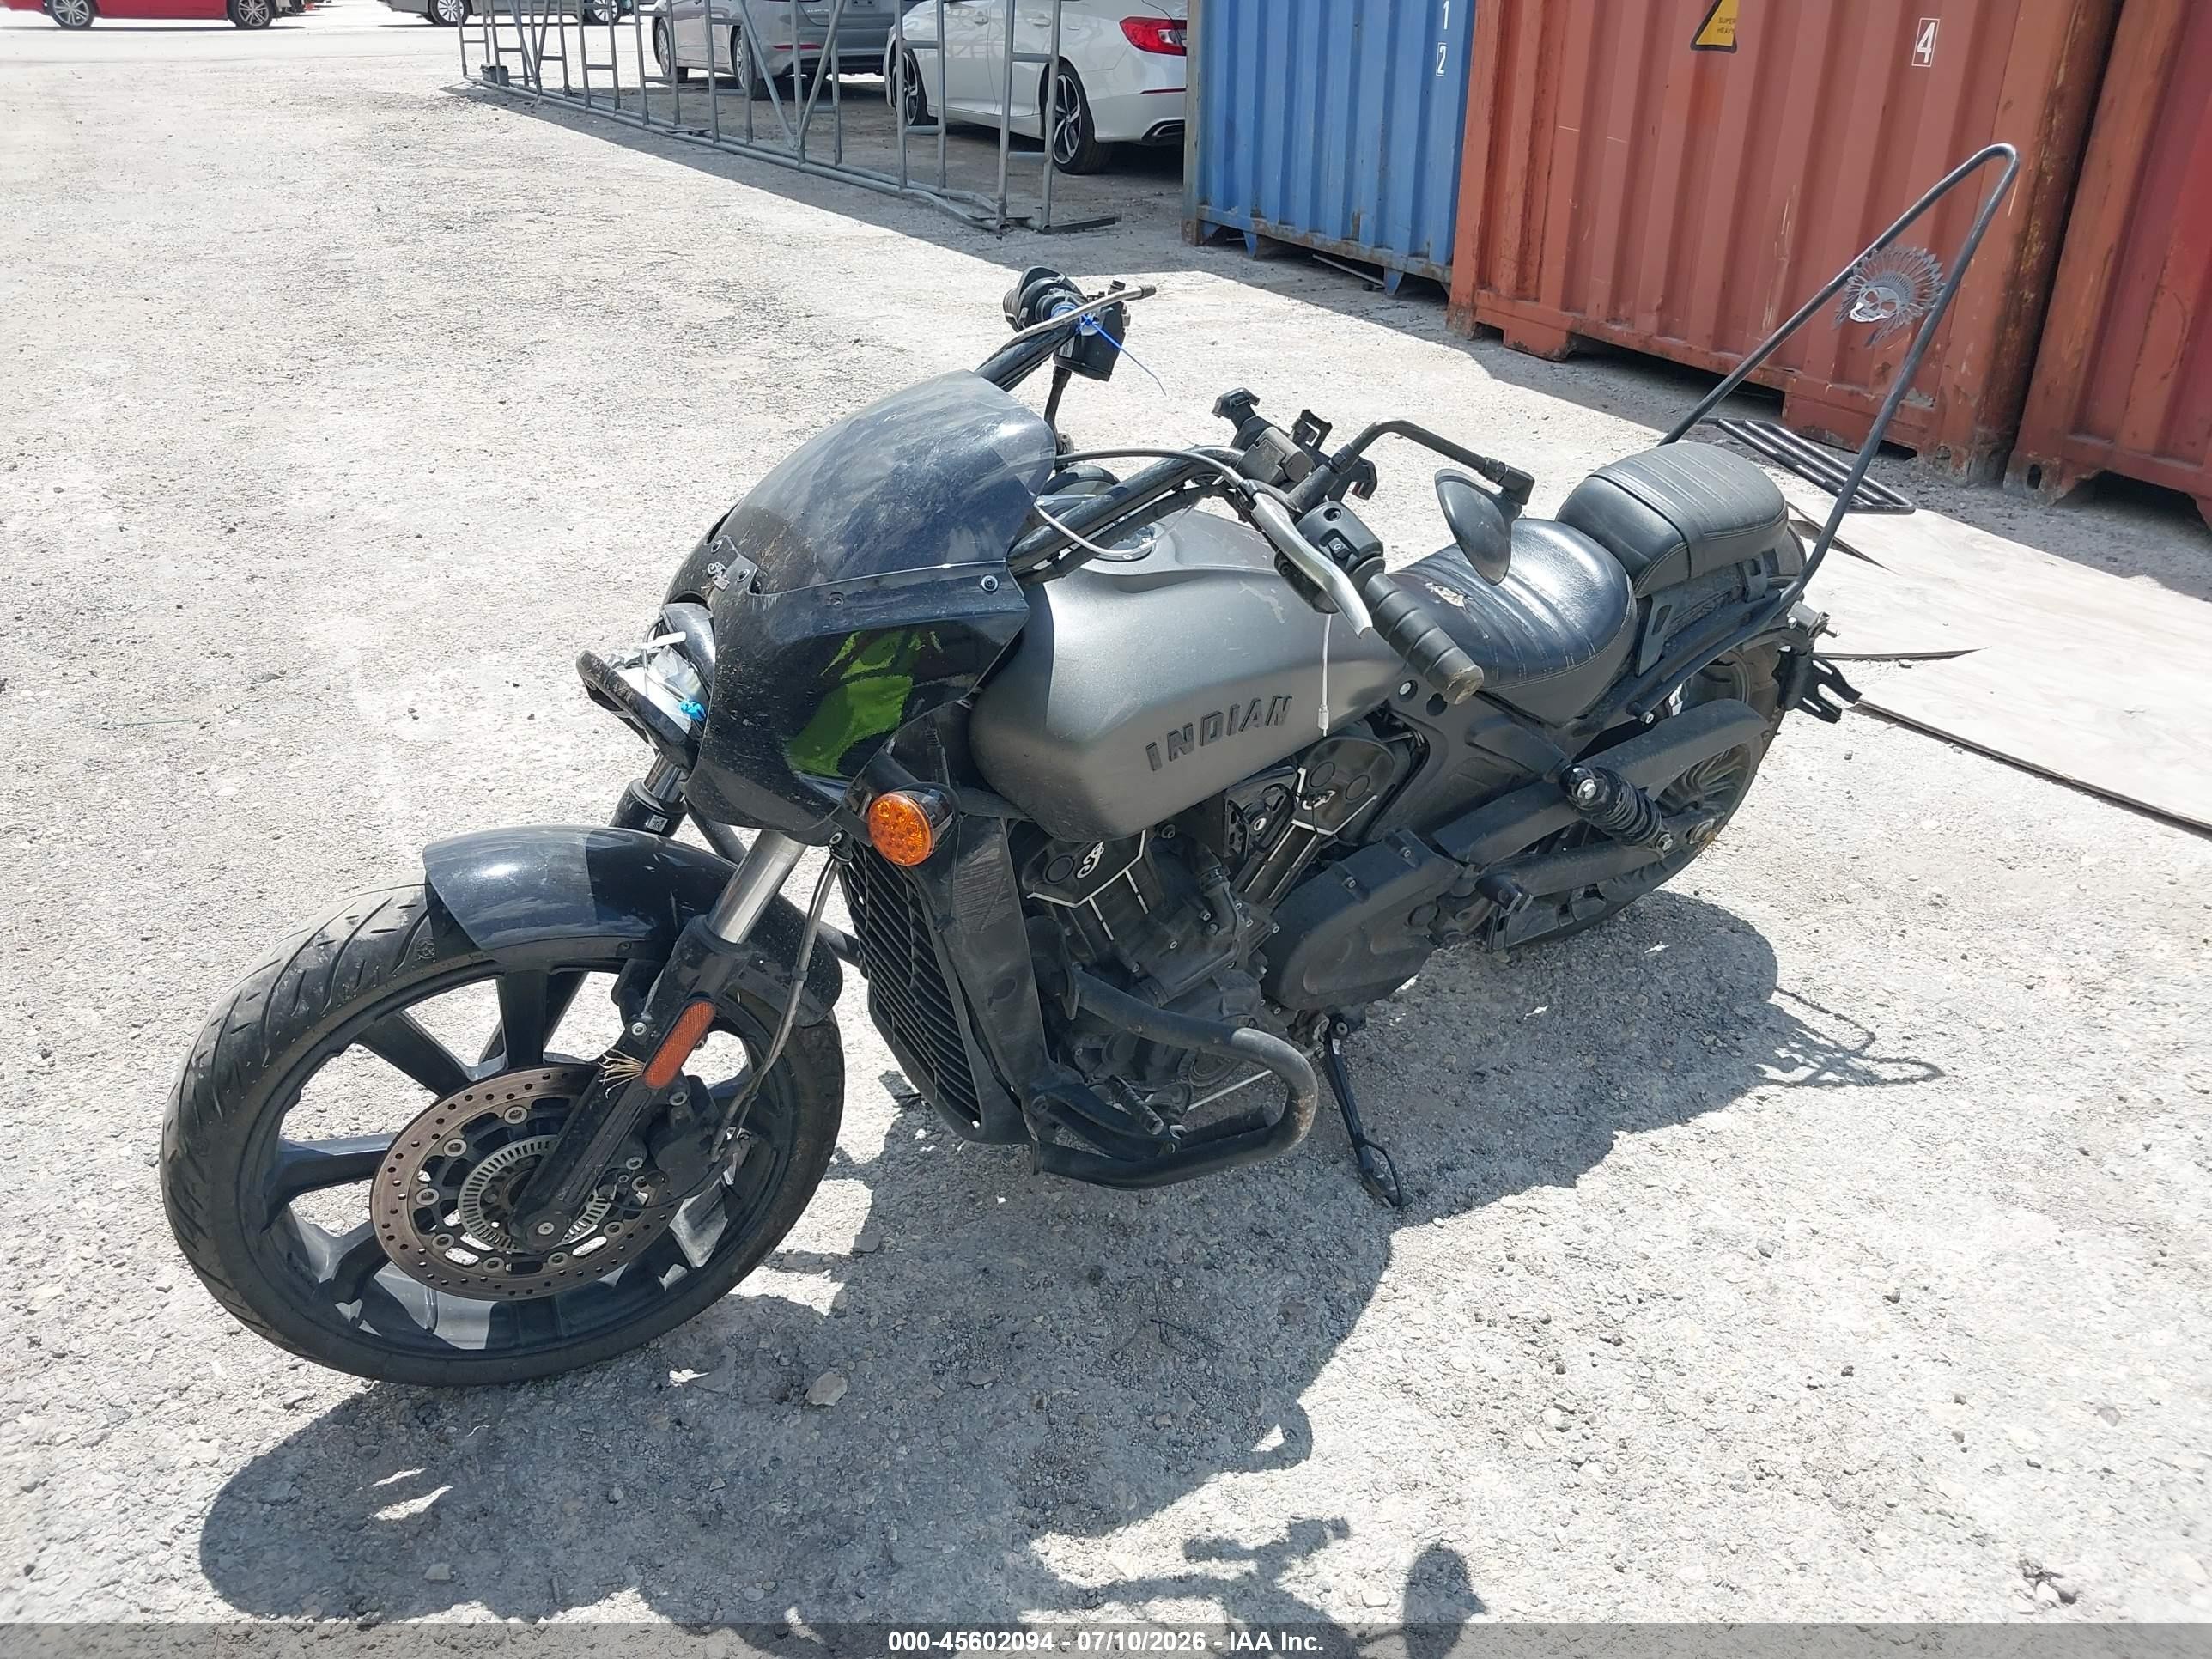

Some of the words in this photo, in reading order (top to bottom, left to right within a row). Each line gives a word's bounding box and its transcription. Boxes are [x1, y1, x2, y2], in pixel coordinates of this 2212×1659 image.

[1437, 45, 1447, 74] 2
[1917, 22, 1936, 64] 4
[1146, 696, 1293, 771] INDIAN
